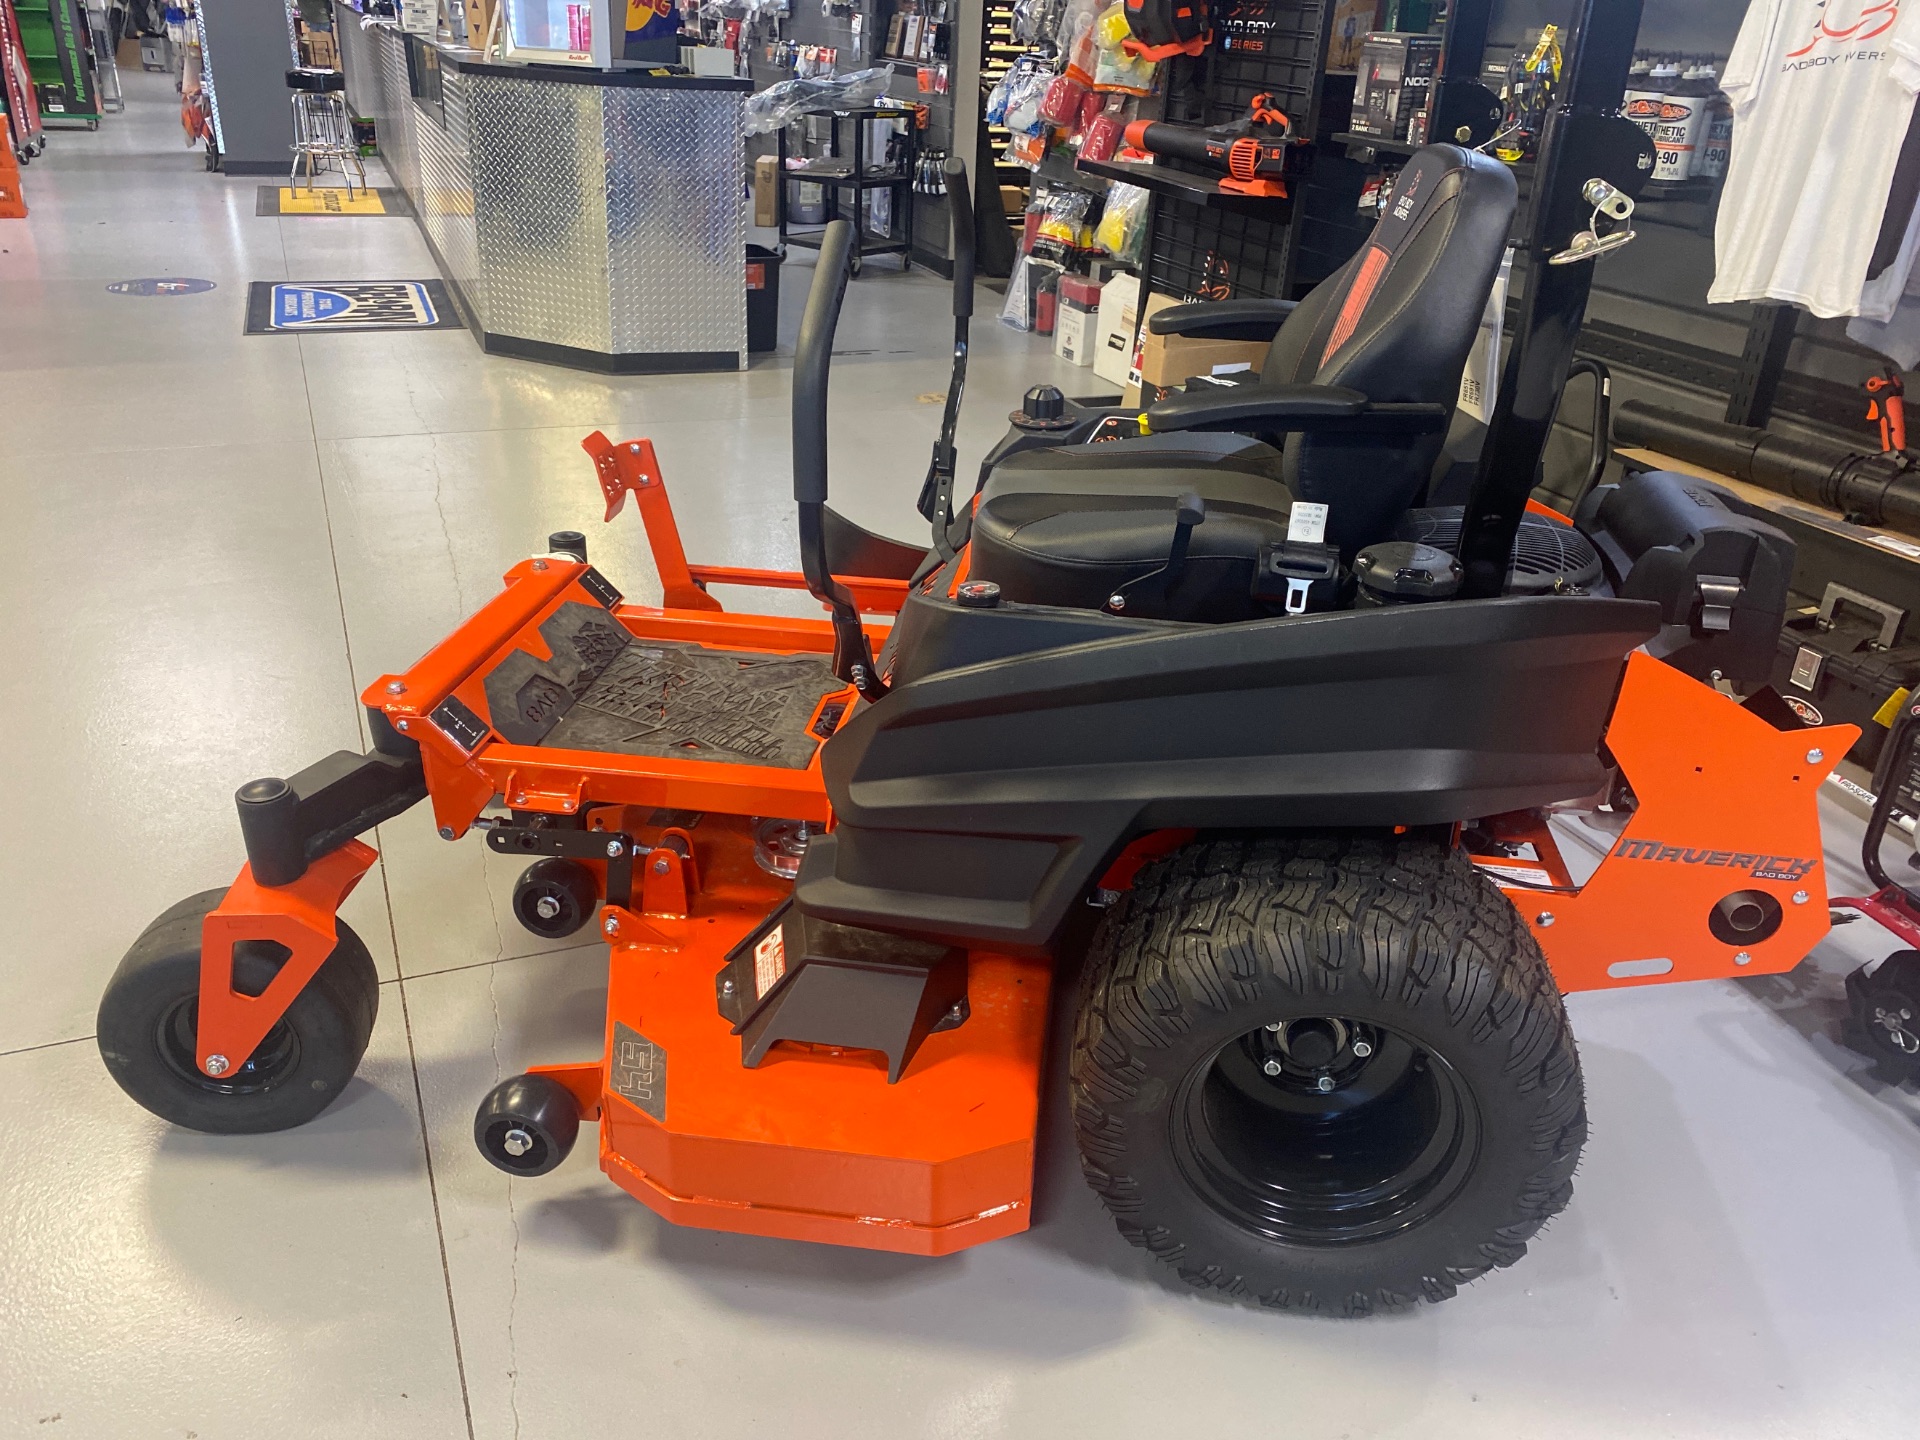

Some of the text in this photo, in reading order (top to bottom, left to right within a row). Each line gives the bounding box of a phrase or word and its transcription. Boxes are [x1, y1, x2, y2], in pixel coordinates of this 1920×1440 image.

[64, 32, 76, 49] Oils
[1231, 39, 1264, 51] SERIES
[68, 49, 86, 103] Performance
[1406, 117, 1415, 145] NOCO
[1657, 151, 1679, 165] -90
[1840, 778, 1876, 804] PRO-SCAPE
[1613, 837, 1818, 874] MAVERICK
[1755, 871, 1776, 879] BAD
[618, 1040, 655, 1100] 54
